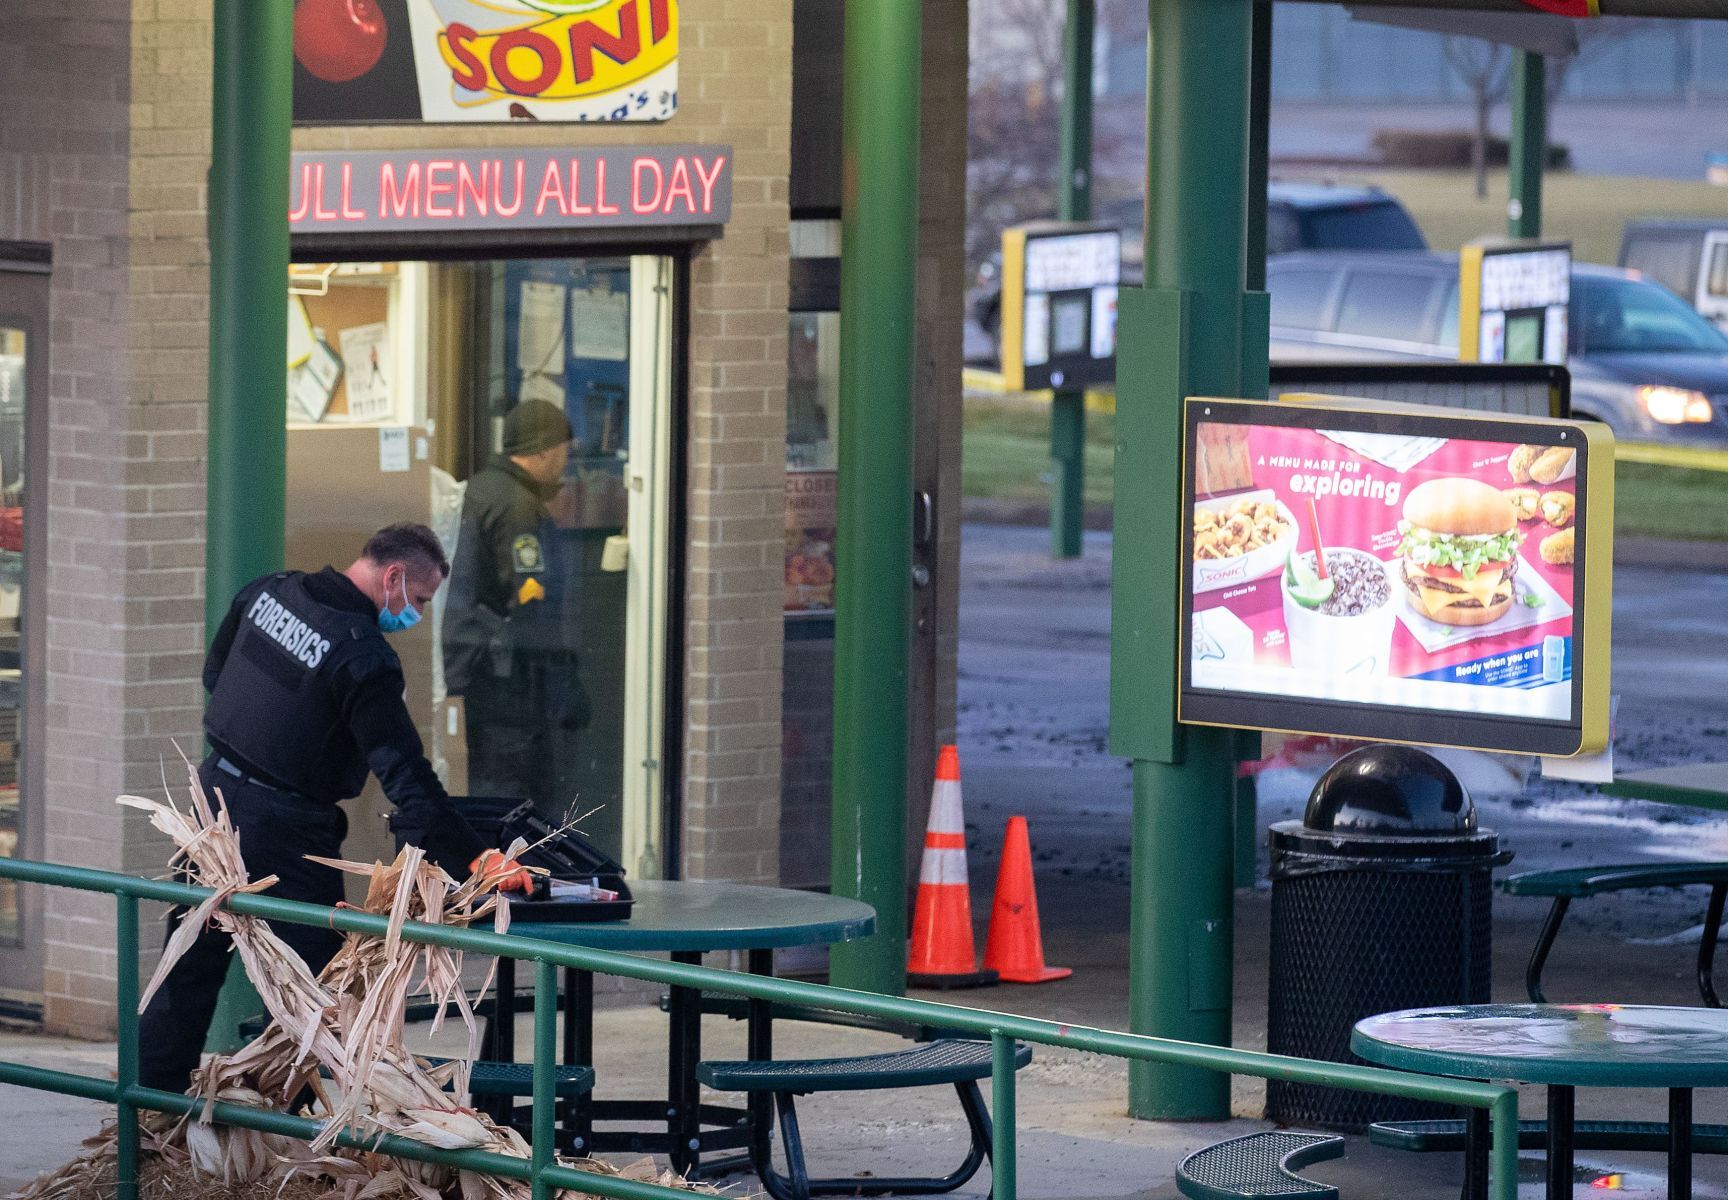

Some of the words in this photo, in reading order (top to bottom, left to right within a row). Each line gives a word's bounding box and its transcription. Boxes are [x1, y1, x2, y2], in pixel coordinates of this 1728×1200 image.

[289, 161, 366, 222] ULL
[379, 159, 525, 219] MENU
[534, 156, 620, 216] ALL
[631, 155, 725, 215] DAY
[1257, 455, 1266, 466] A
[1269, 456, 1301, 468] MENU
[1303, 459, 1335, 472] MADE
[1339, 461, 1361, 473] FOR
[1289, 471, 1401, 506] exploring
[247, 591, 331, 669] FORENSICS
[1456, 663, 1482, 677] Ready
[1483, 658, 1506, 669] when
[1507, 652, 1523, 667] you
[1525, 649, 1538, 660] are
